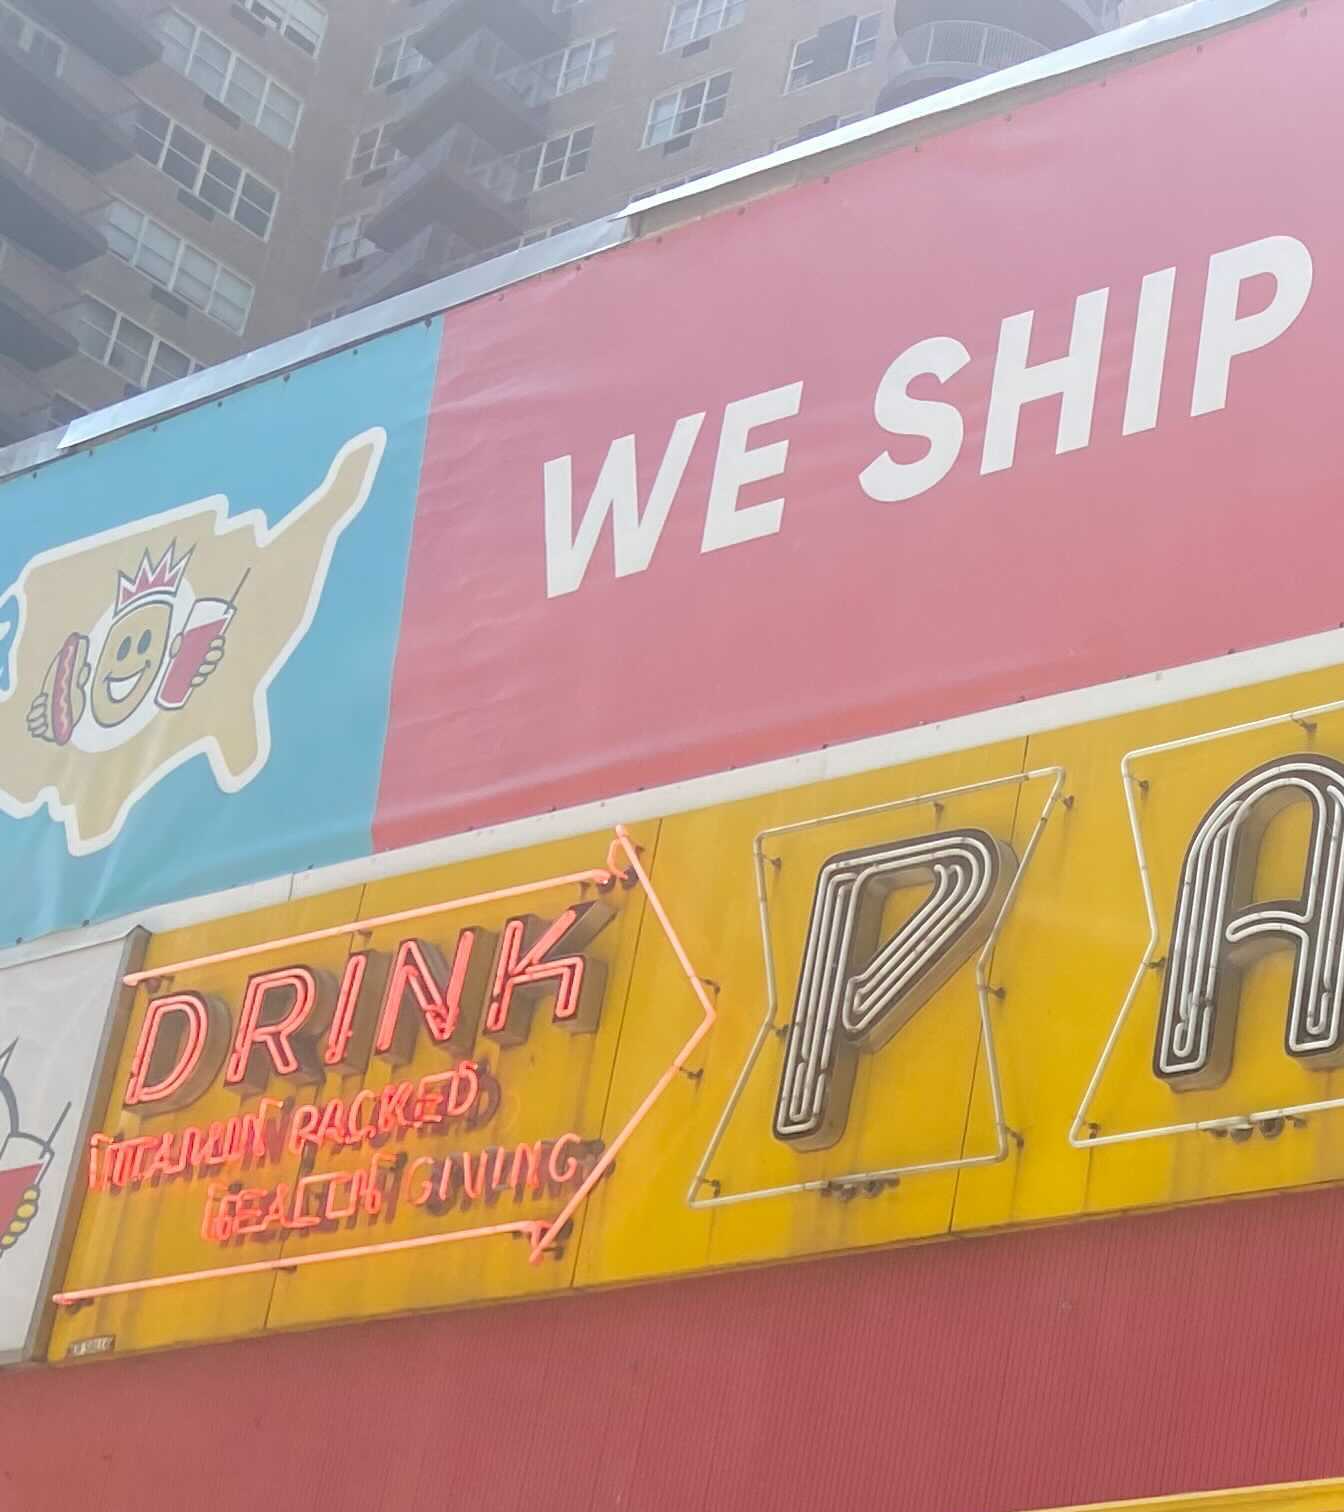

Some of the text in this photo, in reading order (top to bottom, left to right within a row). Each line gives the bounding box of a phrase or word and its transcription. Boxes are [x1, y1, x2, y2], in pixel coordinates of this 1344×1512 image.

[543, 381, 803, 598] WE
[859, 235, 1313, 502] SHIP
[122, 903, 605, 1114] DRINK
[404, 1134, 584, 1208] GIVING
